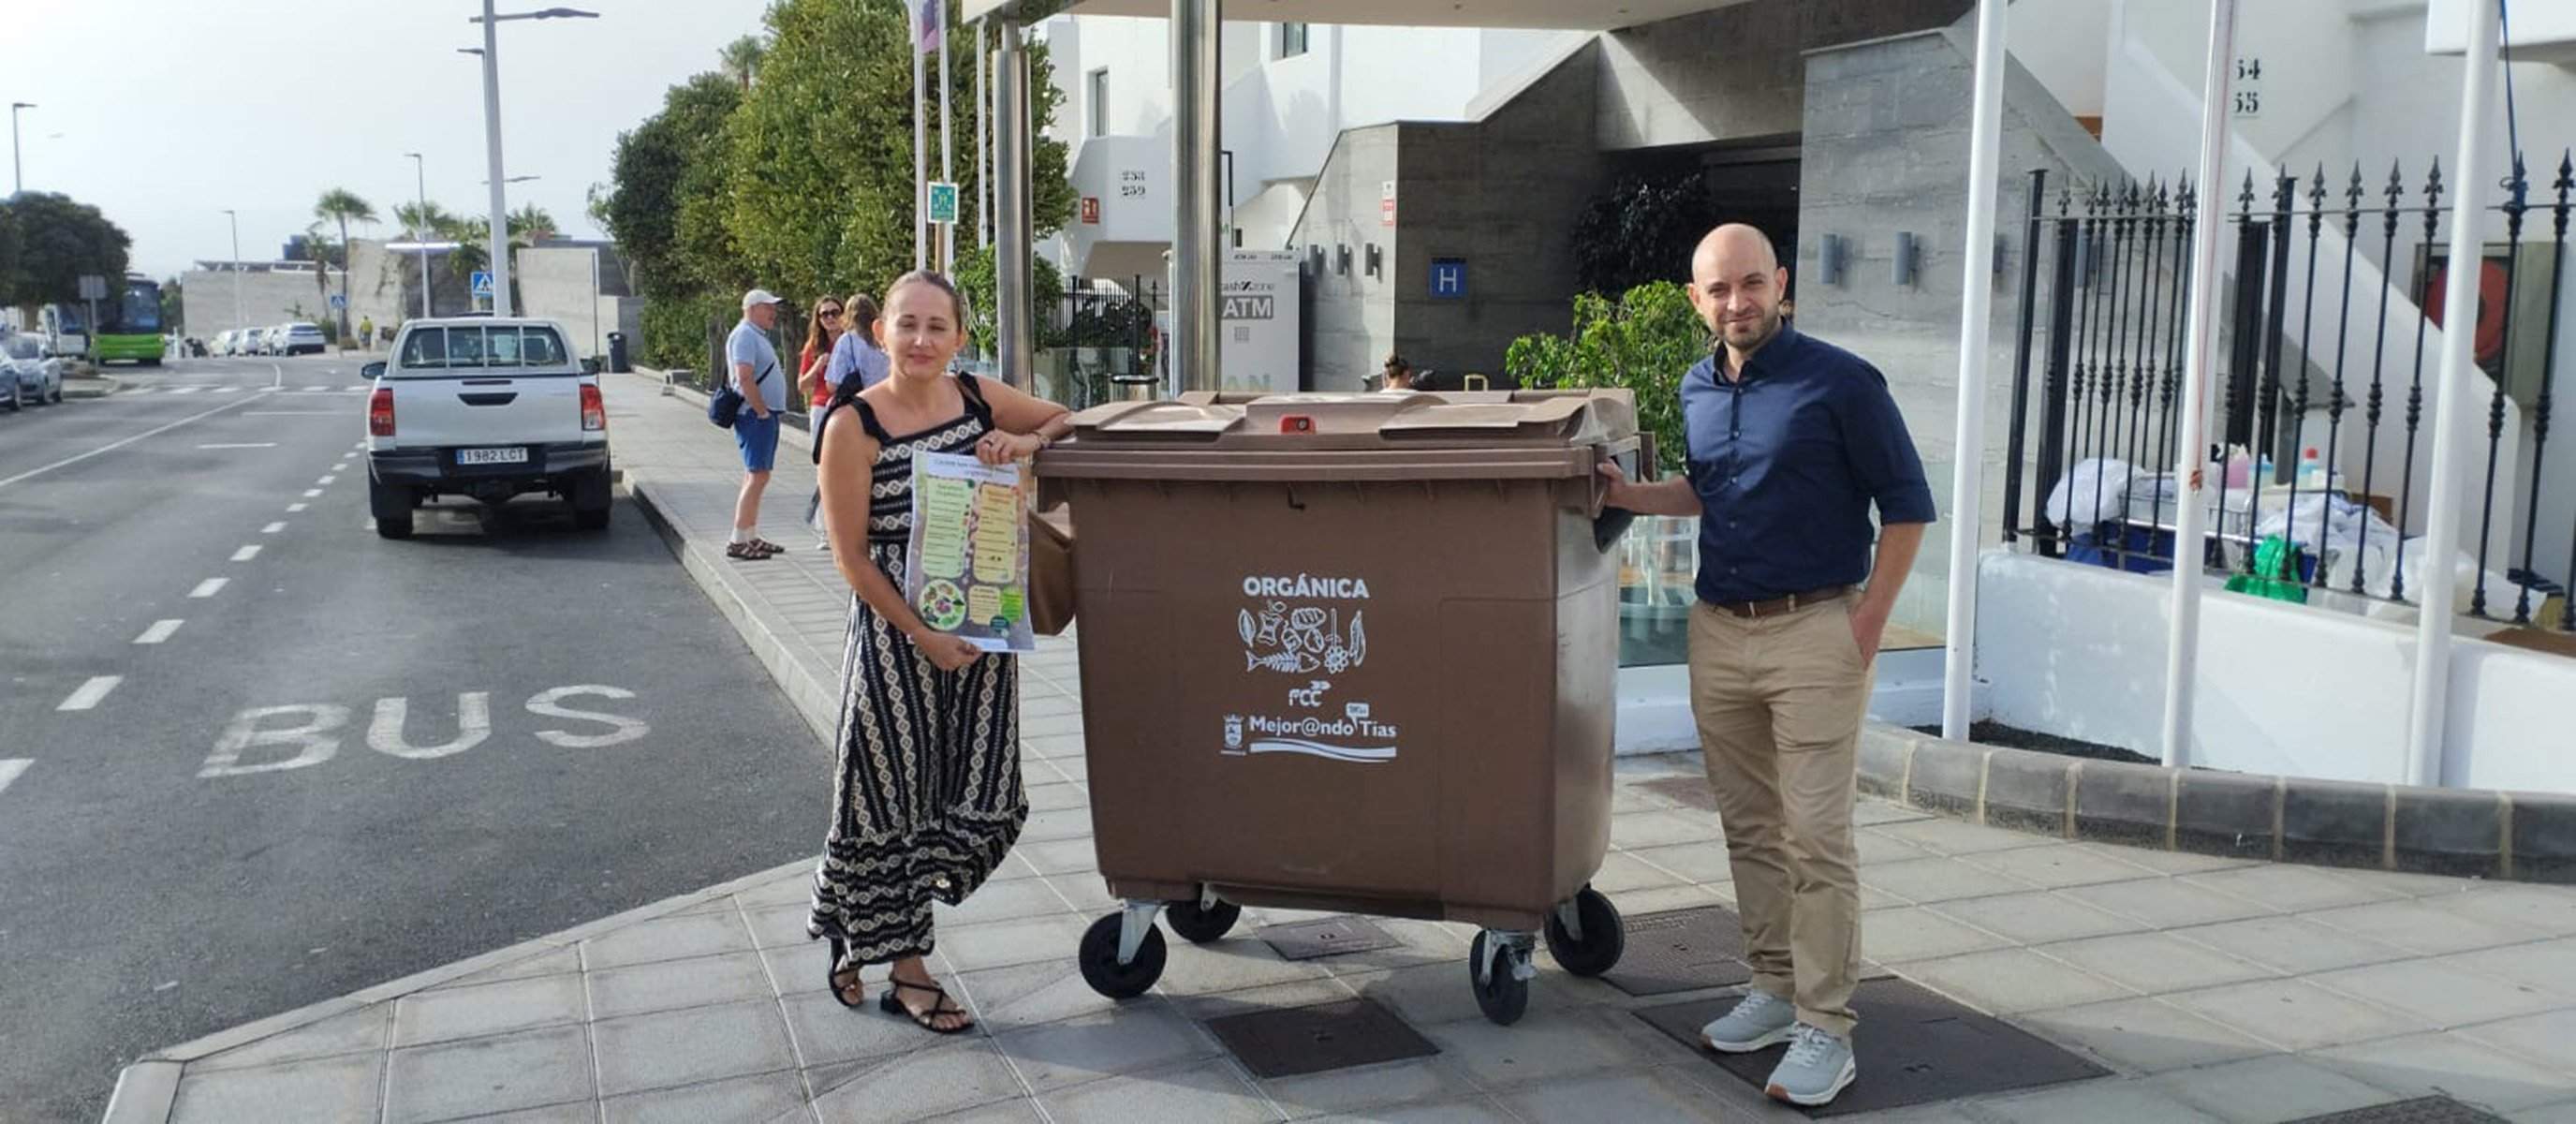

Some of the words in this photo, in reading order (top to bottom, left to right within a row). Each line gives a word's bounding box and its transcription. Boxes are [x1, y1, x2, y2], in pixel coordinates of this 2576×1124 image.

[1439, 267, 1457, 292] H
[1222, 298, 1273, 318] ATM
[465, 451, 496, 462] 1982
[500, 449, 525, 461] LCT
[1243, 572, 1371, 599] ORGÁNICA
[195, 683, 652, 779] BUS
[1249, 715, 1354, 737] Mejor@ndo
